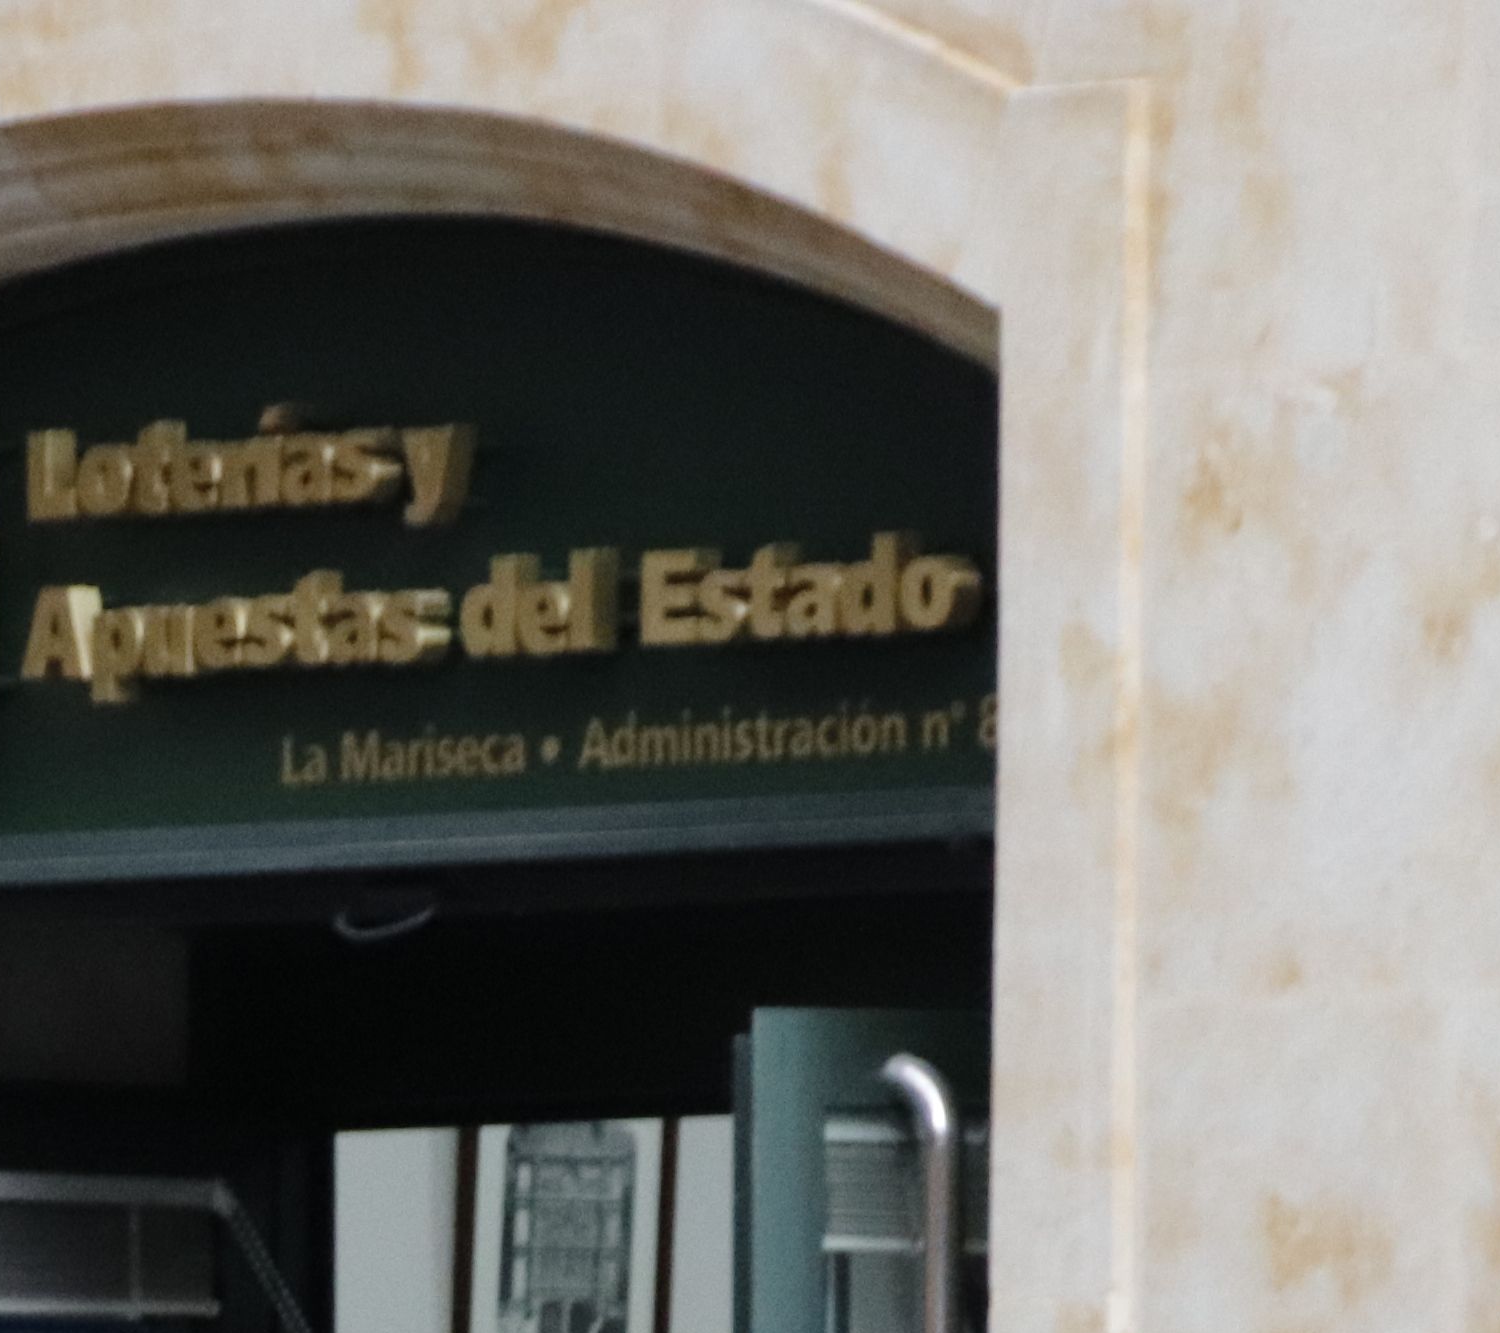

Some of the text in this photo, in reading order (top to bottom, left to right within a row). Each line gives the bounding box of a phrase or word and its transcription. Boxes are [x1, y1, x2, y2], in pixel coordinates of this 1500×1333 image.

[26, 402, 475, 528] Loterías y
[20, 530, 982, 704] Apuestas del Estado
[280, 733, 328, 784] La
[340, 722, 528, 783] Mariseca
[577, 702, 907, 769] Administración
